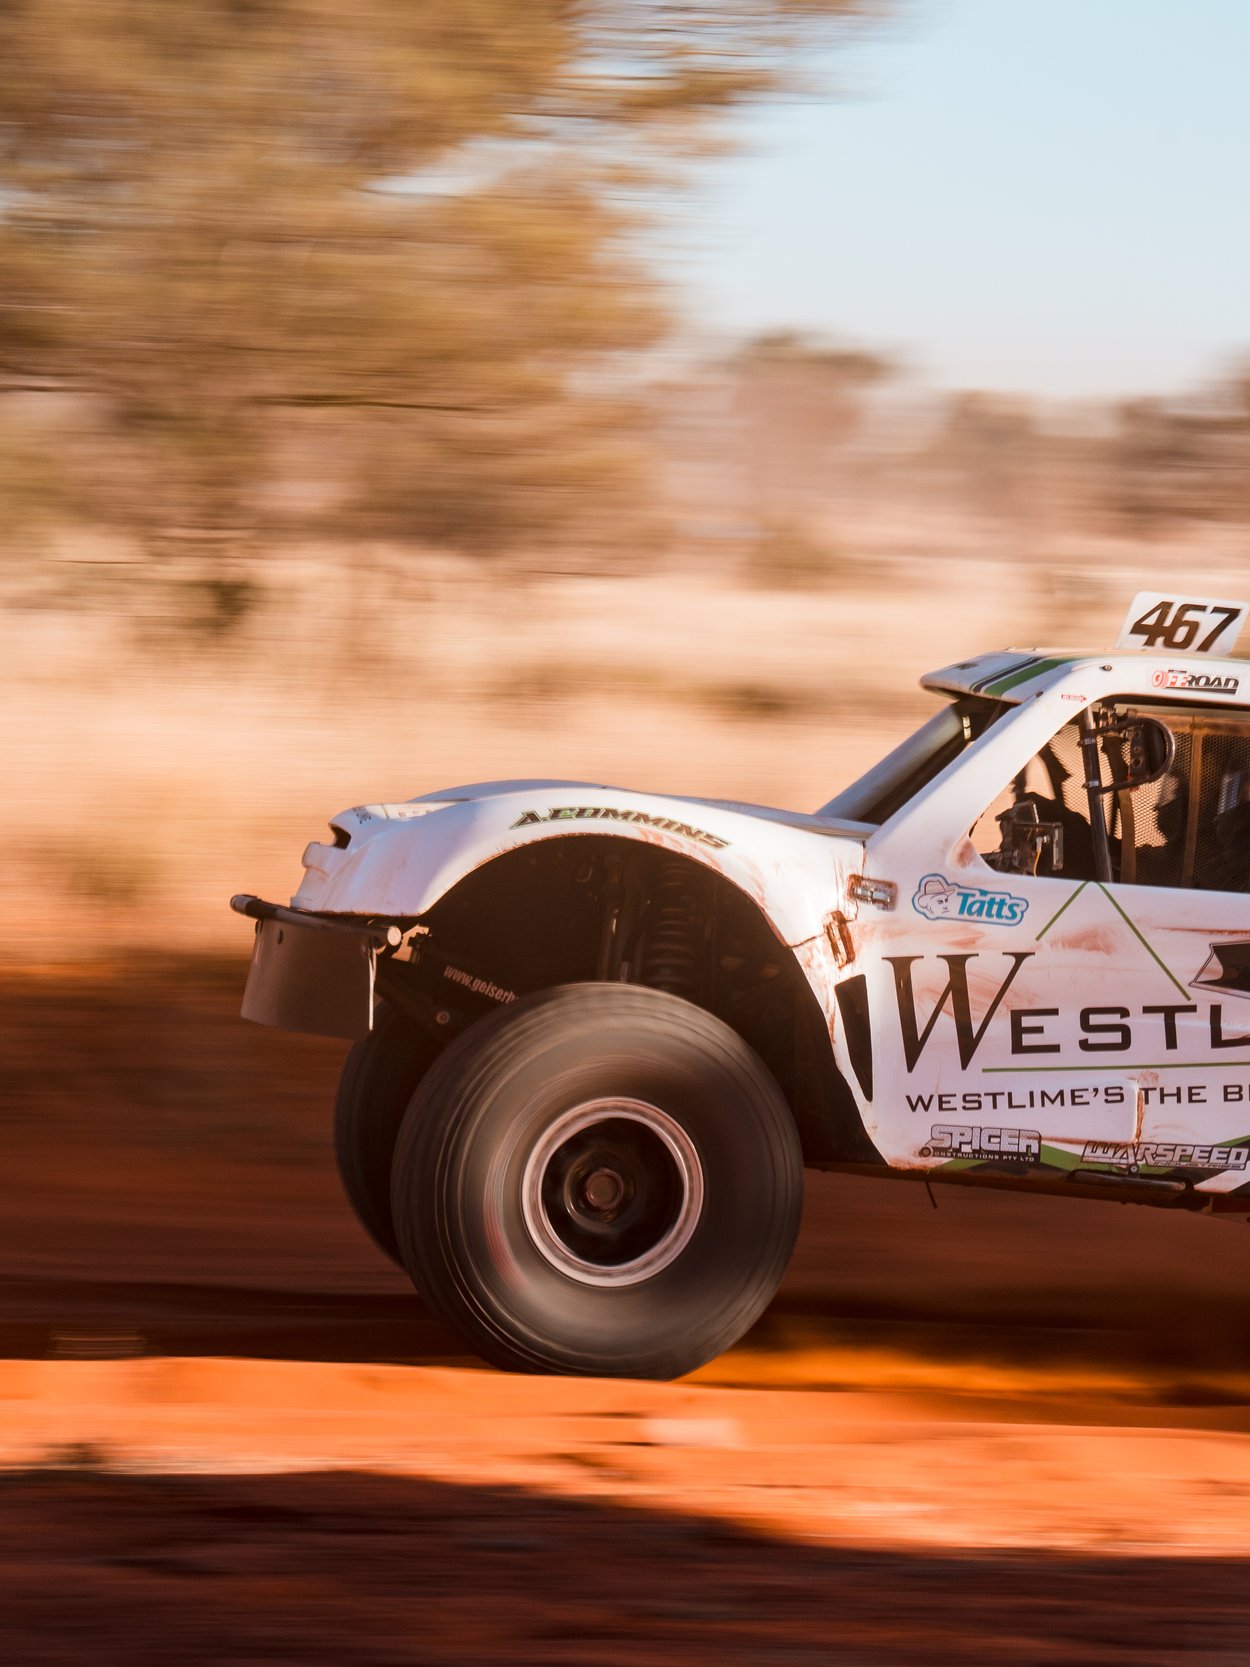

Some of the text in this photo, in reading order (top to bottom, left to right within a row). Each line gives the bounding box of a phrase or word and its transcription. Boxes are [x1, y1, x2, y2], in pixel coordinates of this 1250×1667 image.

[1129, 601, 1241, 652] 467
[956, 892, 1024, 921] Tatts
[906, 1086, 1125, 1112] WESTLIME'S
[1141, 1085, 1207, 1105] THE
[928, 1125, 1041, 1154] SPICER
[1083, 1142, 1249, 1166] WARSPEED
